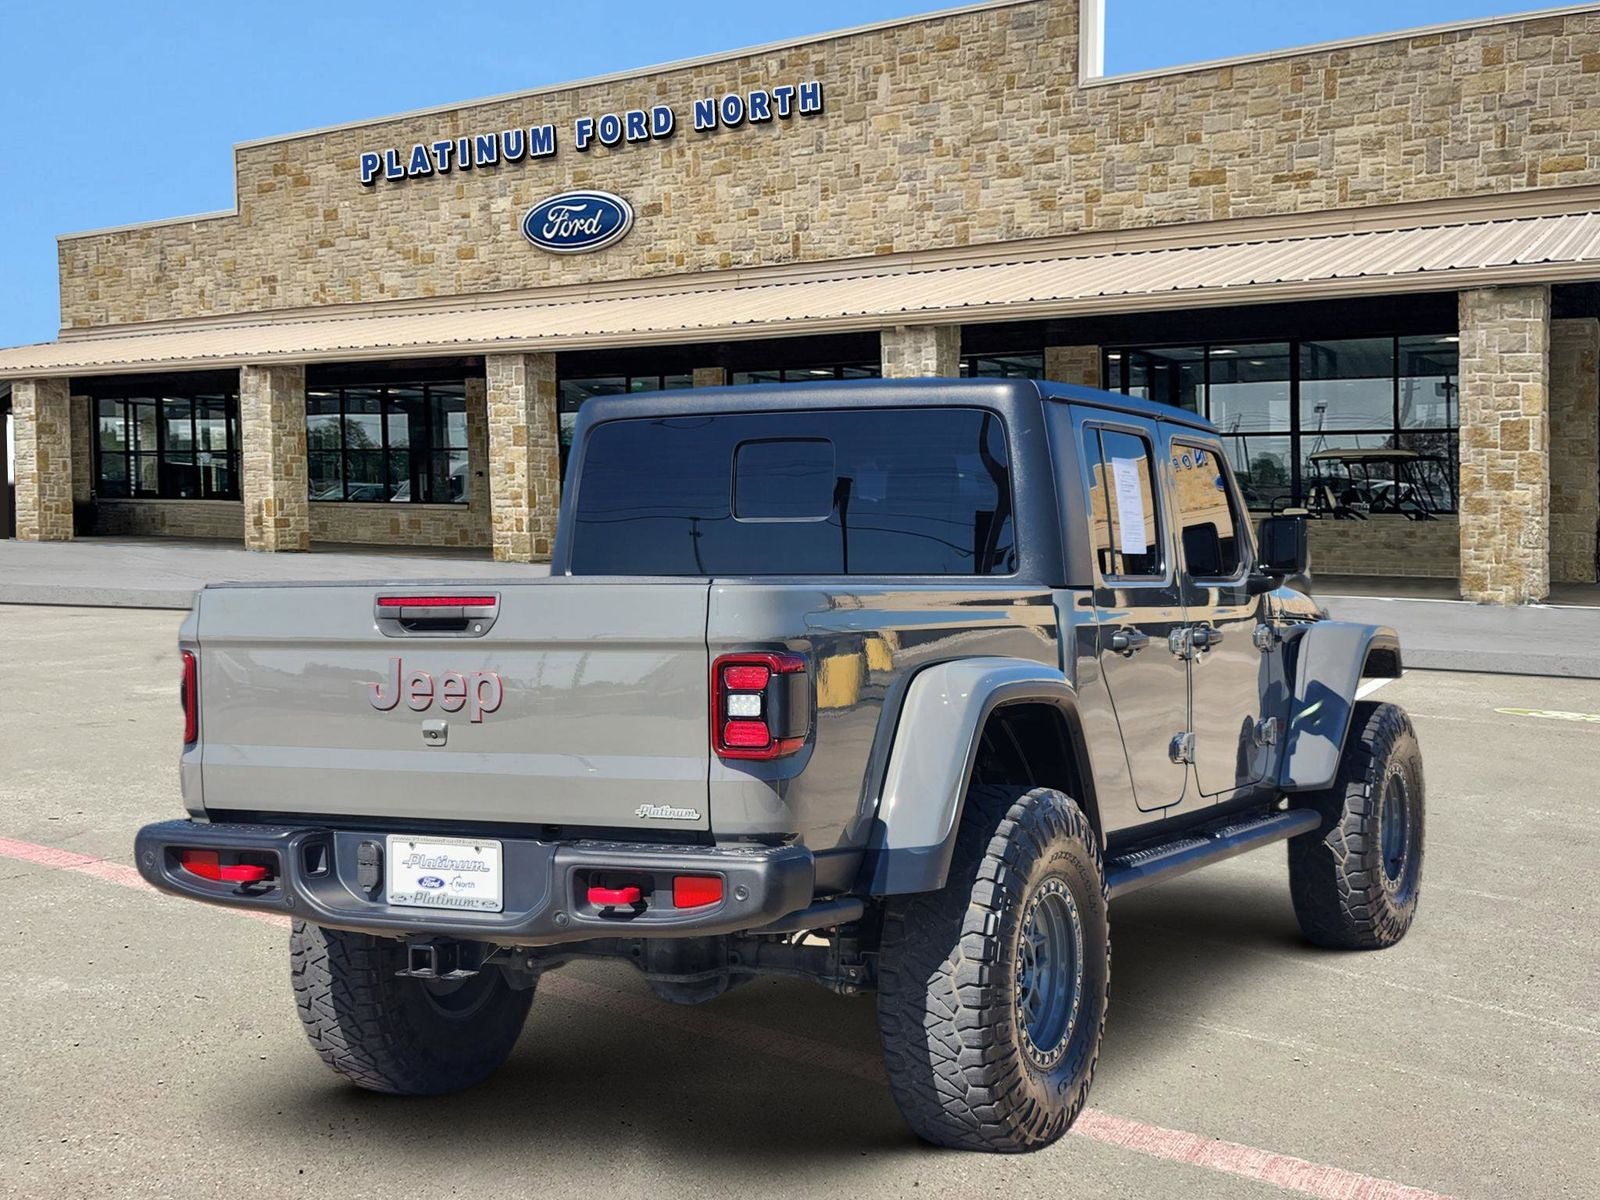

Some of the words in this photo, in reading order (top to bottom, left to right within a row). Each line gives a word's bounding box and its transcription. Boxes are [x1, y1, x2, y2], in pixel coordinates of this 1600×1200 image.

[360, 125, 557, 186] PLATINUM
[575, 105, 676, 150] FORD
[693, 81, 823, 131] NORTH
[542, 203, 602, 240] Ford
[367, 656, 504, 724] Jeep
[635, 804, 700, 820] Platinum
[402, 853, 490, 872] Platinum
[421, 877, 442, 888] Ford
[455, 880, 476, 889] North
[414, 892, 475, 908] Platinum
